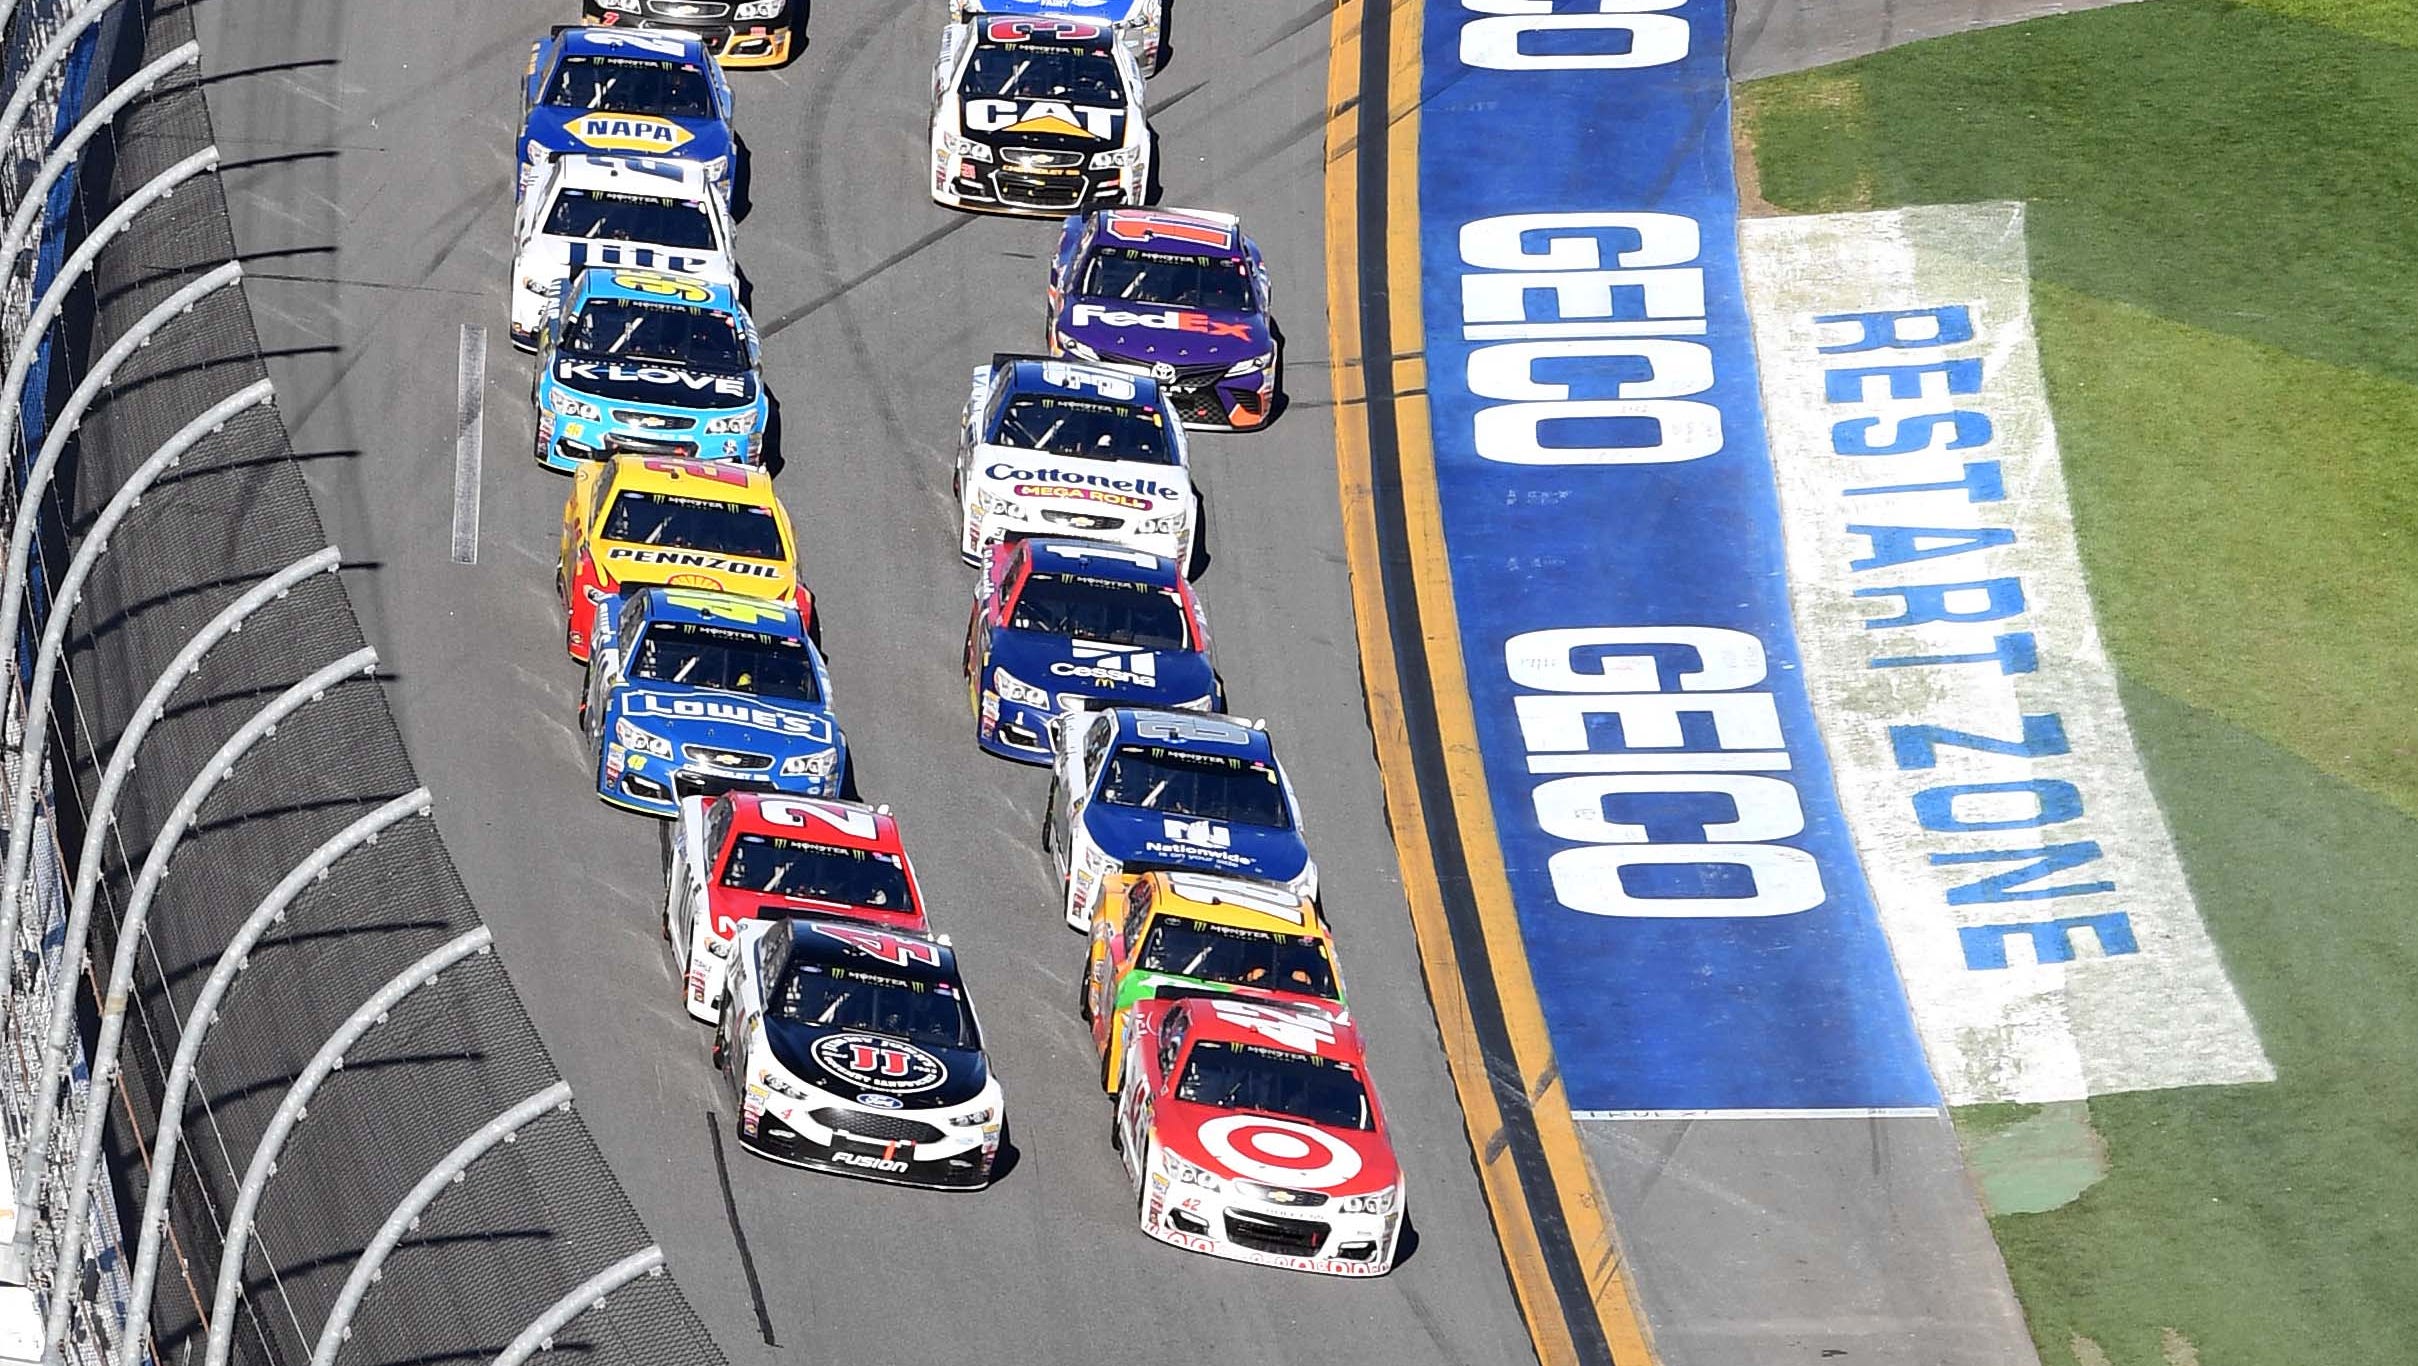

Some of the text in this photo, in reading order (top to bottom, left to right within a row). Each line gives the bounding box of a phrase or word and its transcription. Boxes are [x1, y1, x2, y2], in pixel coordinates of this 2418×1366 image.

[587, 121, 673, 142] NAPA
[966, 99, 1124, 141] CAT
[1072, 304, 1253, 343] FedEx
[1459, 212, 1724, 465] GEICO
[985, 463, 1179, 500] Cottonelle
[1021, 485, 1147, 510] MEGA ROLL
[610, 548, 781, 579] PENNZOIL
[1813, 305, 2140, 971] RESTART ZONE
[1050, 662, 1156, 688] Cessna
[645, 695, 812, 732] LOWE'S
[1505, 626, 1826, 917] GEICO
[1146, 841, 1251, 866] Nationwide
[811, 923, 941, 967] 4
[832, 1151, 909, 1173] FUSION
[1181, 1197, 1201, 1212] 42
